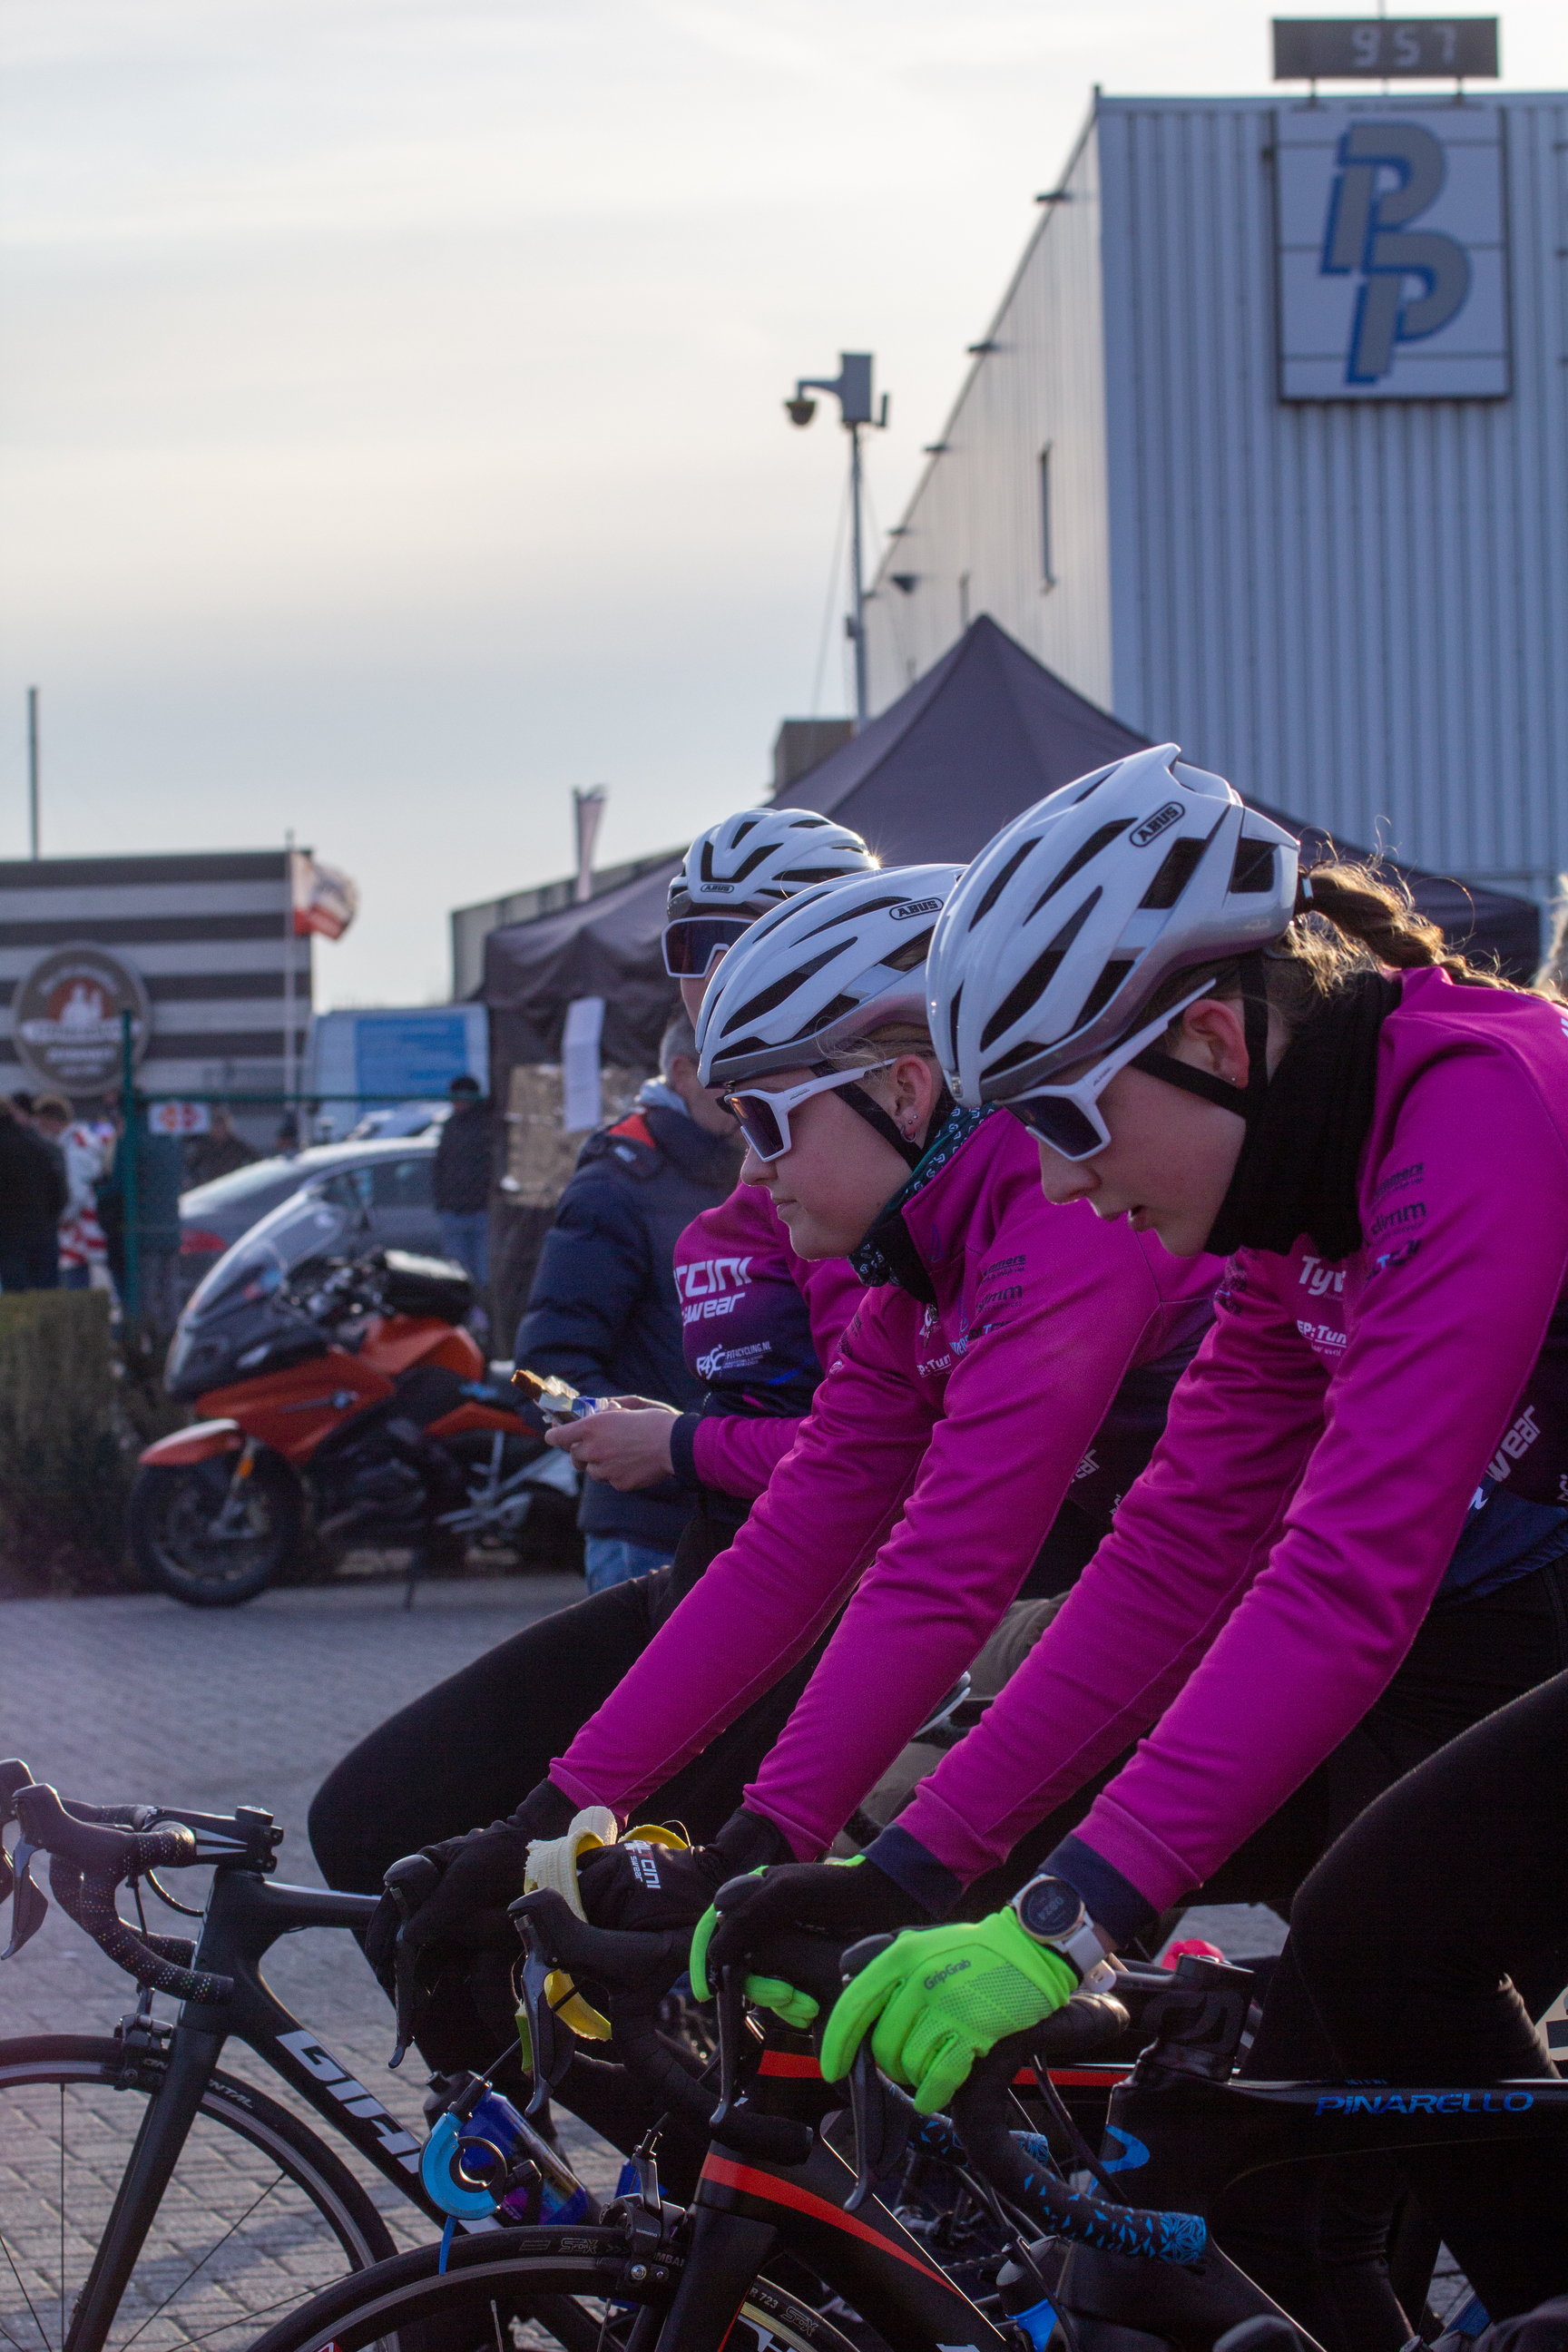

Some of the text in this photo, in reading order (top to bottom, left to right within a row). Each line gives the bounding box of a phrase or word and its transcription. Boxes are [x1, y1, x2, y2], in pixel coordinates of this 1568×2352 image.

[1137, 806, 1180, 843] ABUS
[897, 899, 939, 917] ABUS
[682, 1292, 746, 1327] wear
[924, 1959, 971, 1991] GripGrab
[1315, 2091, 1534, 2115] PINARELLO
[759, 2292, 779, 2308] 723
